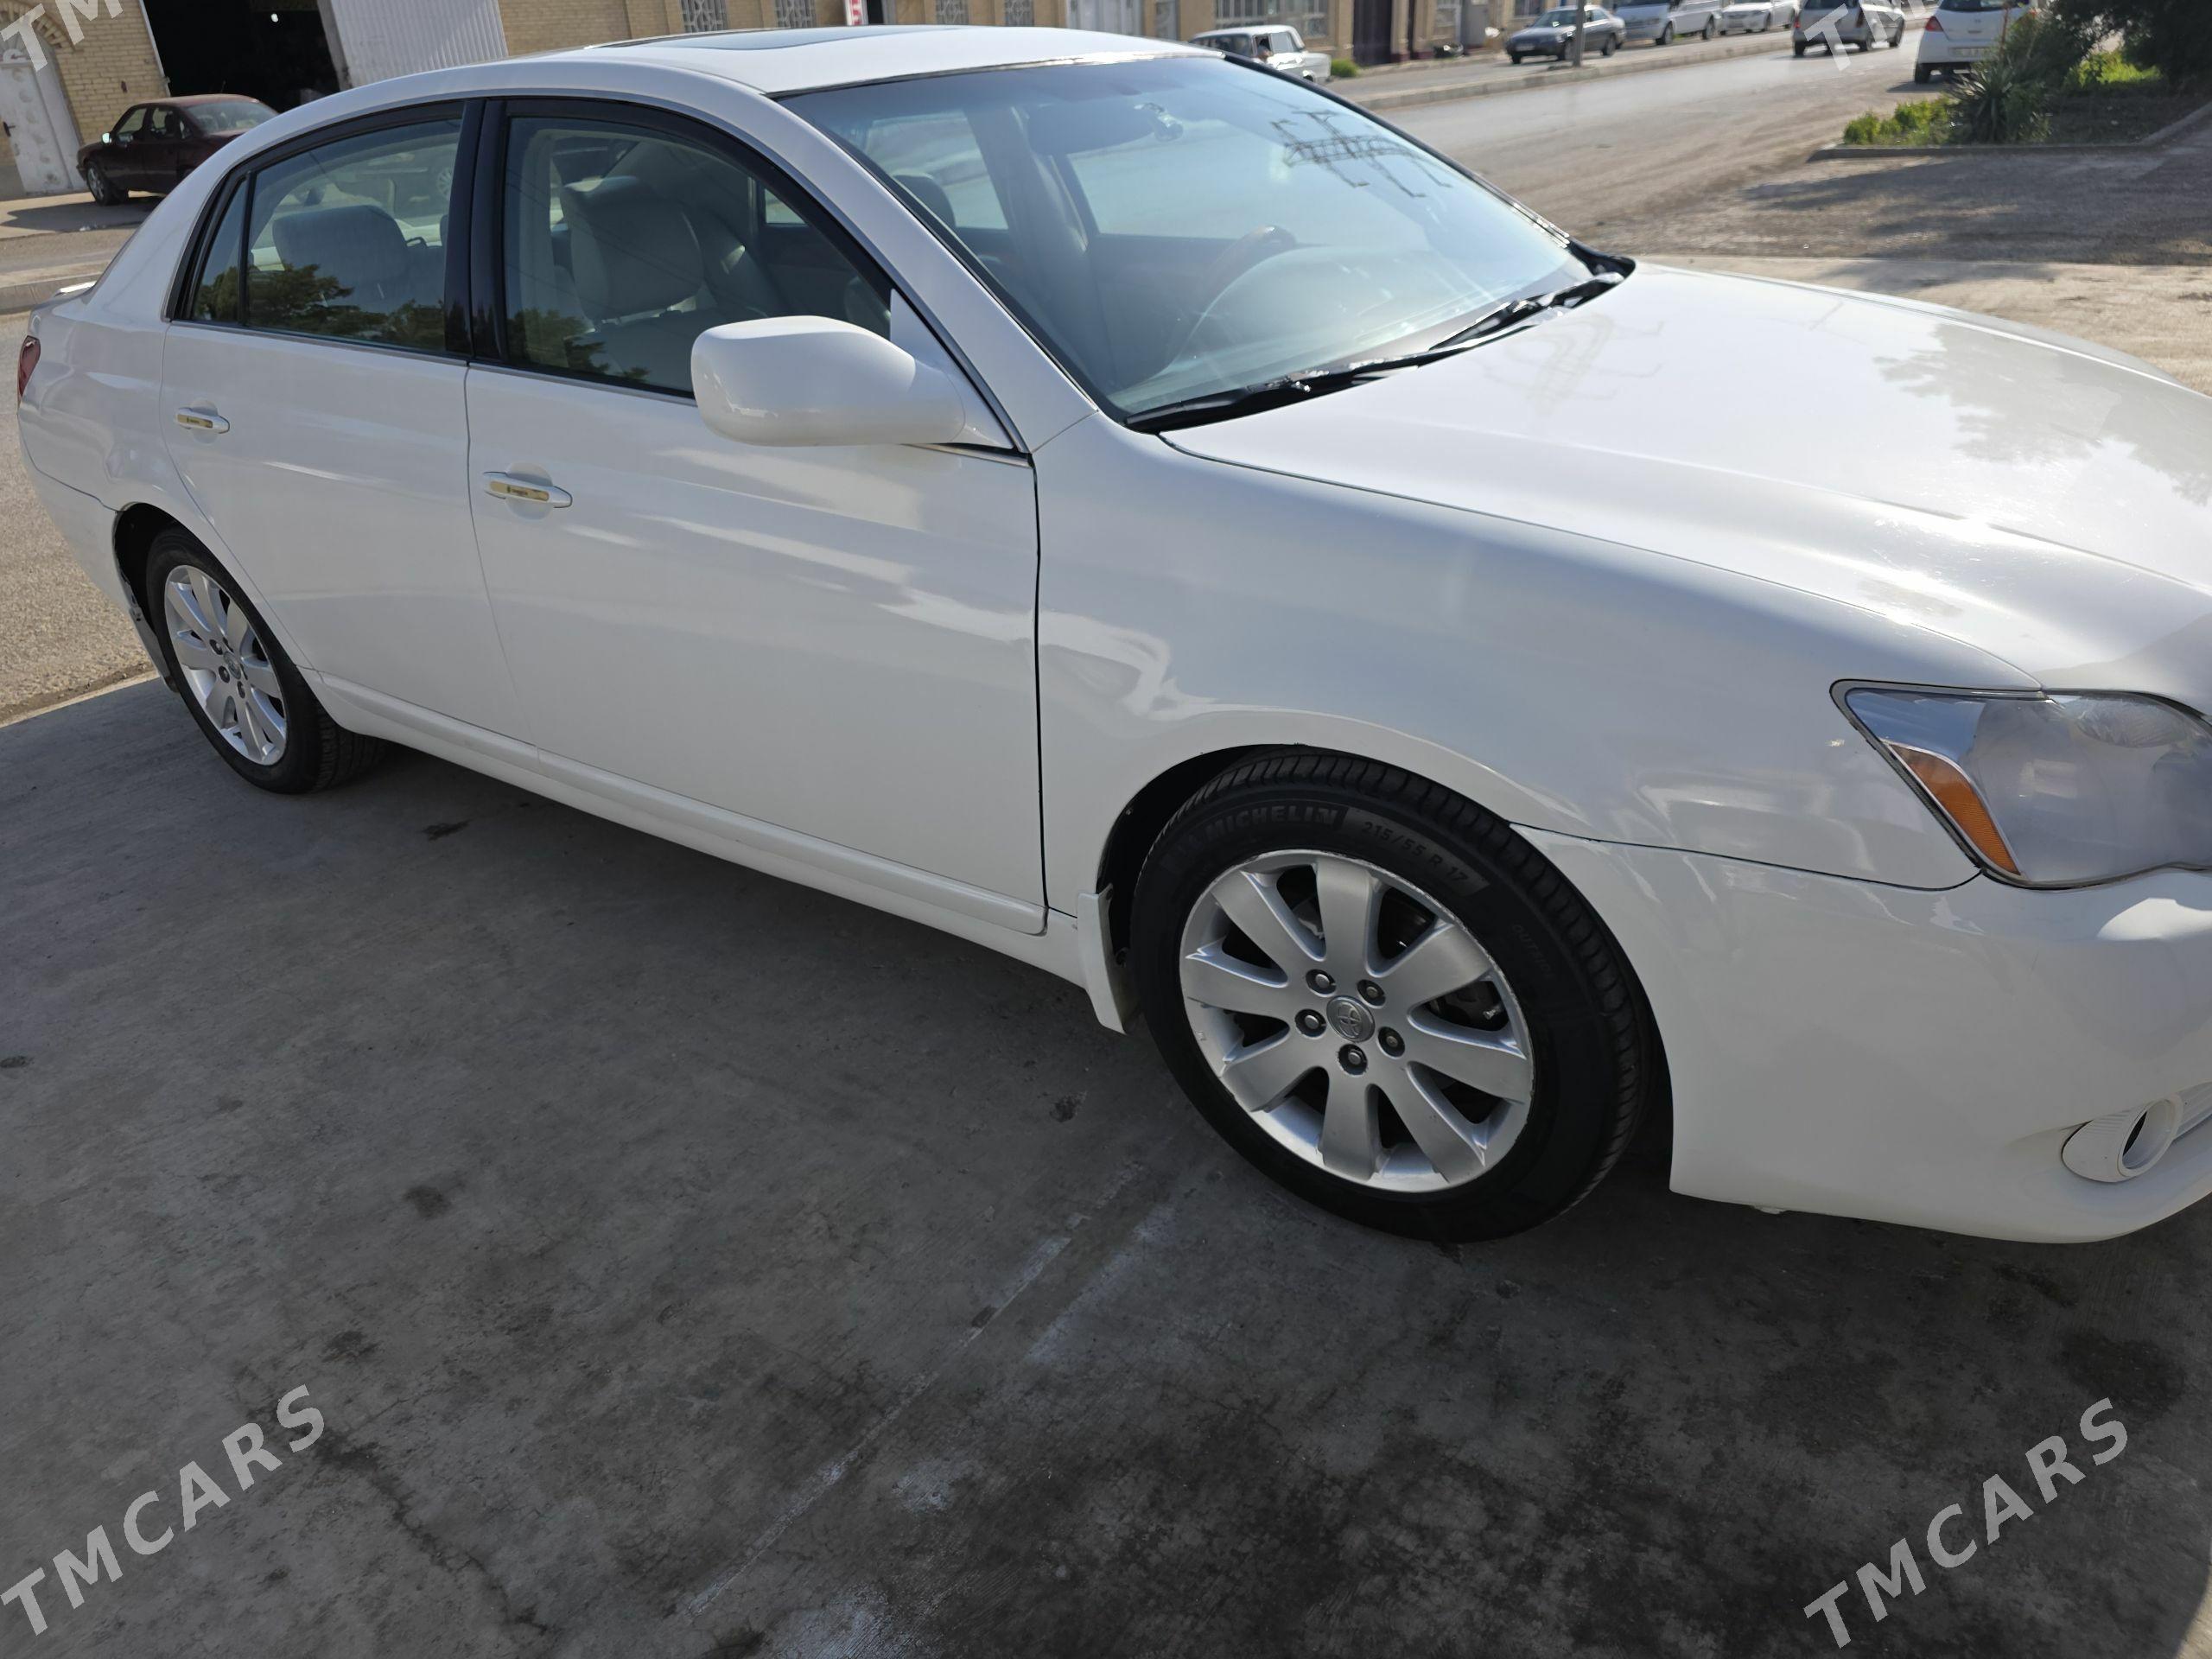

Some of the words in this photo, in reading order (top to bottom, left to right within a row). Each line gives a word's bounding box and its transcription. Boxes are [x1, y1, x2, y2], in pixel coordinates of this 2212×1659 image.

[1208, 804, 1339, 837] MICHELIN
[1361, 821, 1427, 856] 215/55
[1428, 854, 1443, 868] R
[1446, 866, 1468, 881] 17
